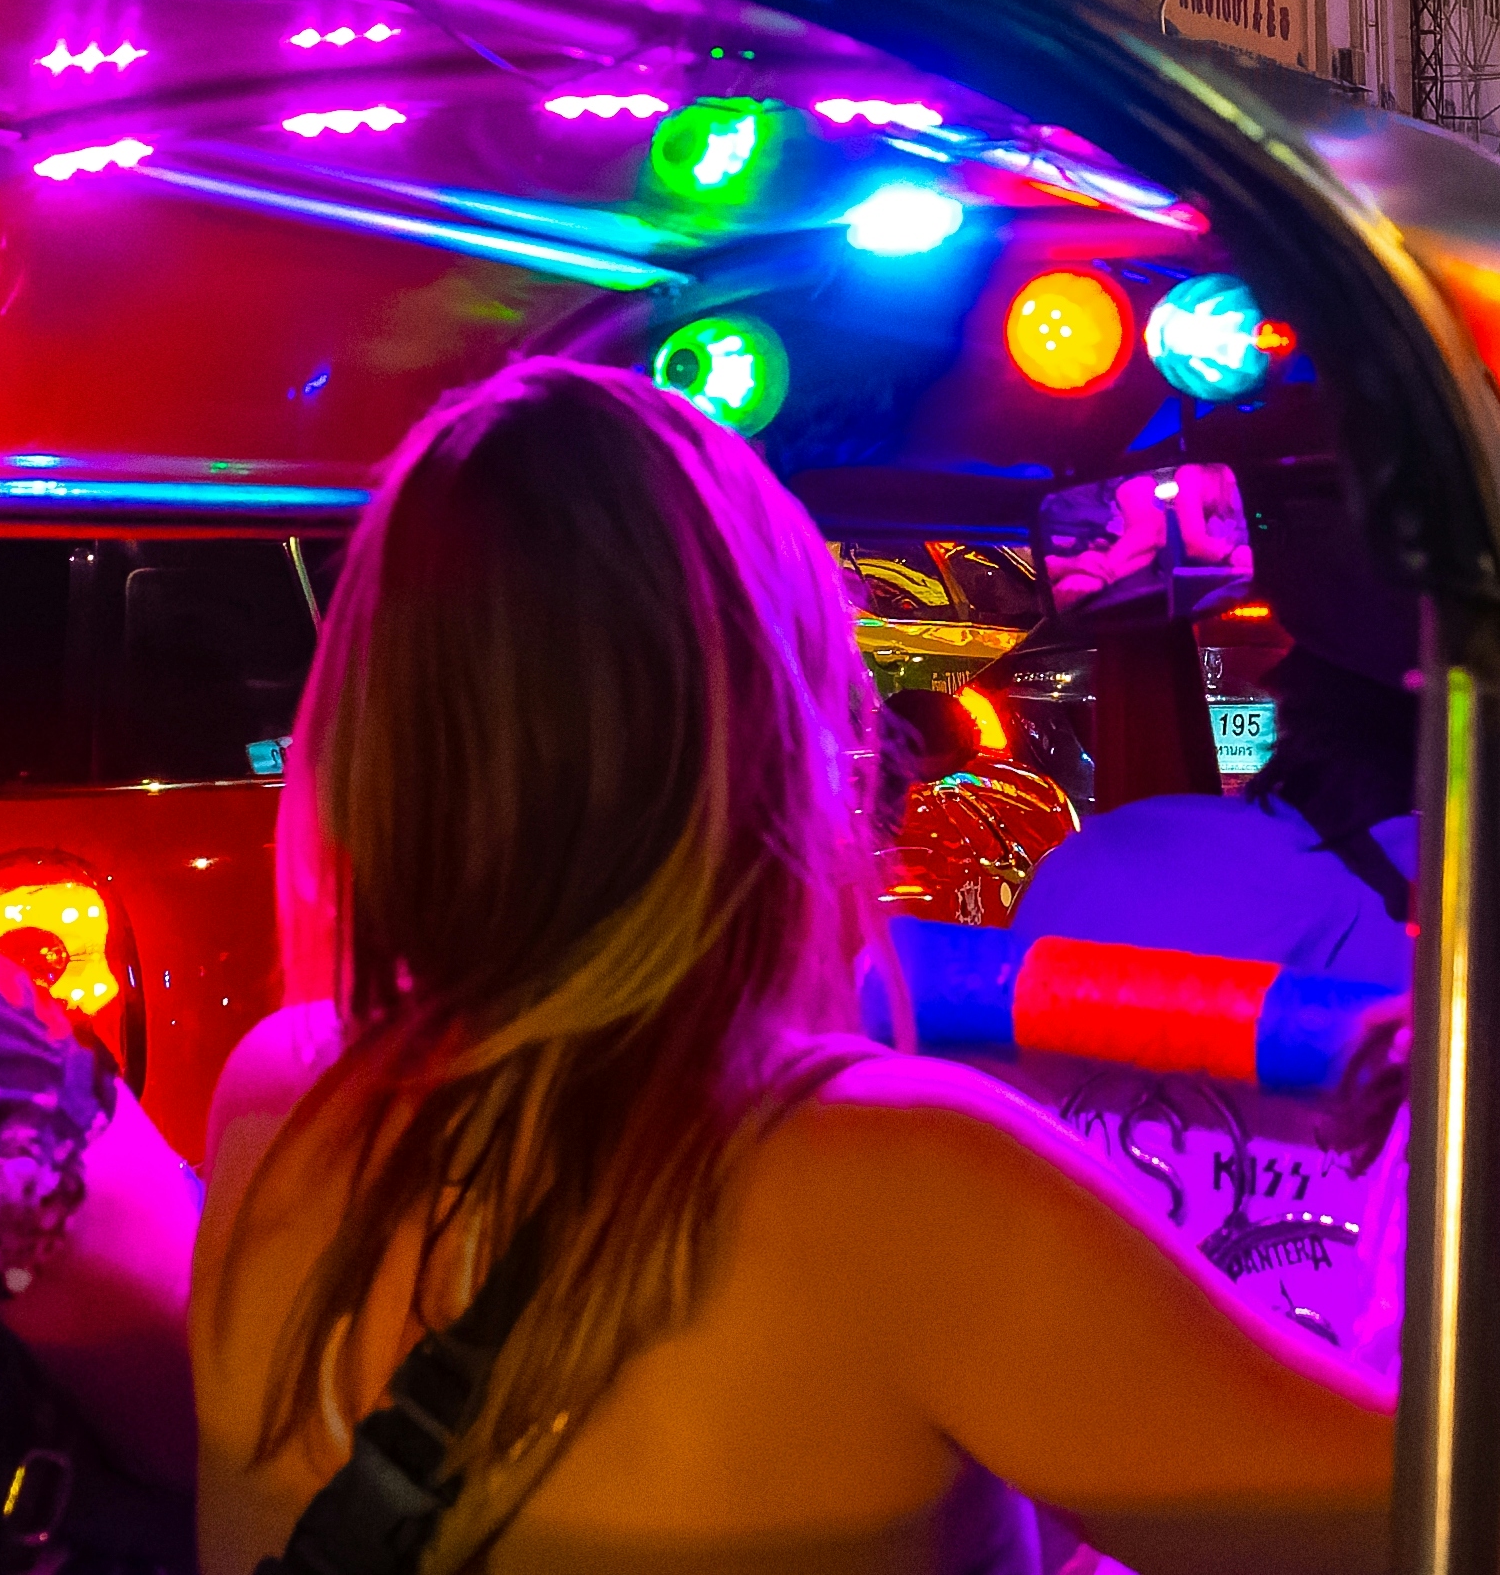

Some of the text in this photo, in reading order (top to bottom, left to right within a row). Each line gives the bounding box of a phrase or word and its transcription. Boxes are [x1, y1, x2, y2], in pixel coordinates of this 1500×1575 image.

[1219, 712, 1262, 737] 195
[1213, 1151, 1311, 1201] KISS
[1226, 1233, 1333, 1282] PANTERA
